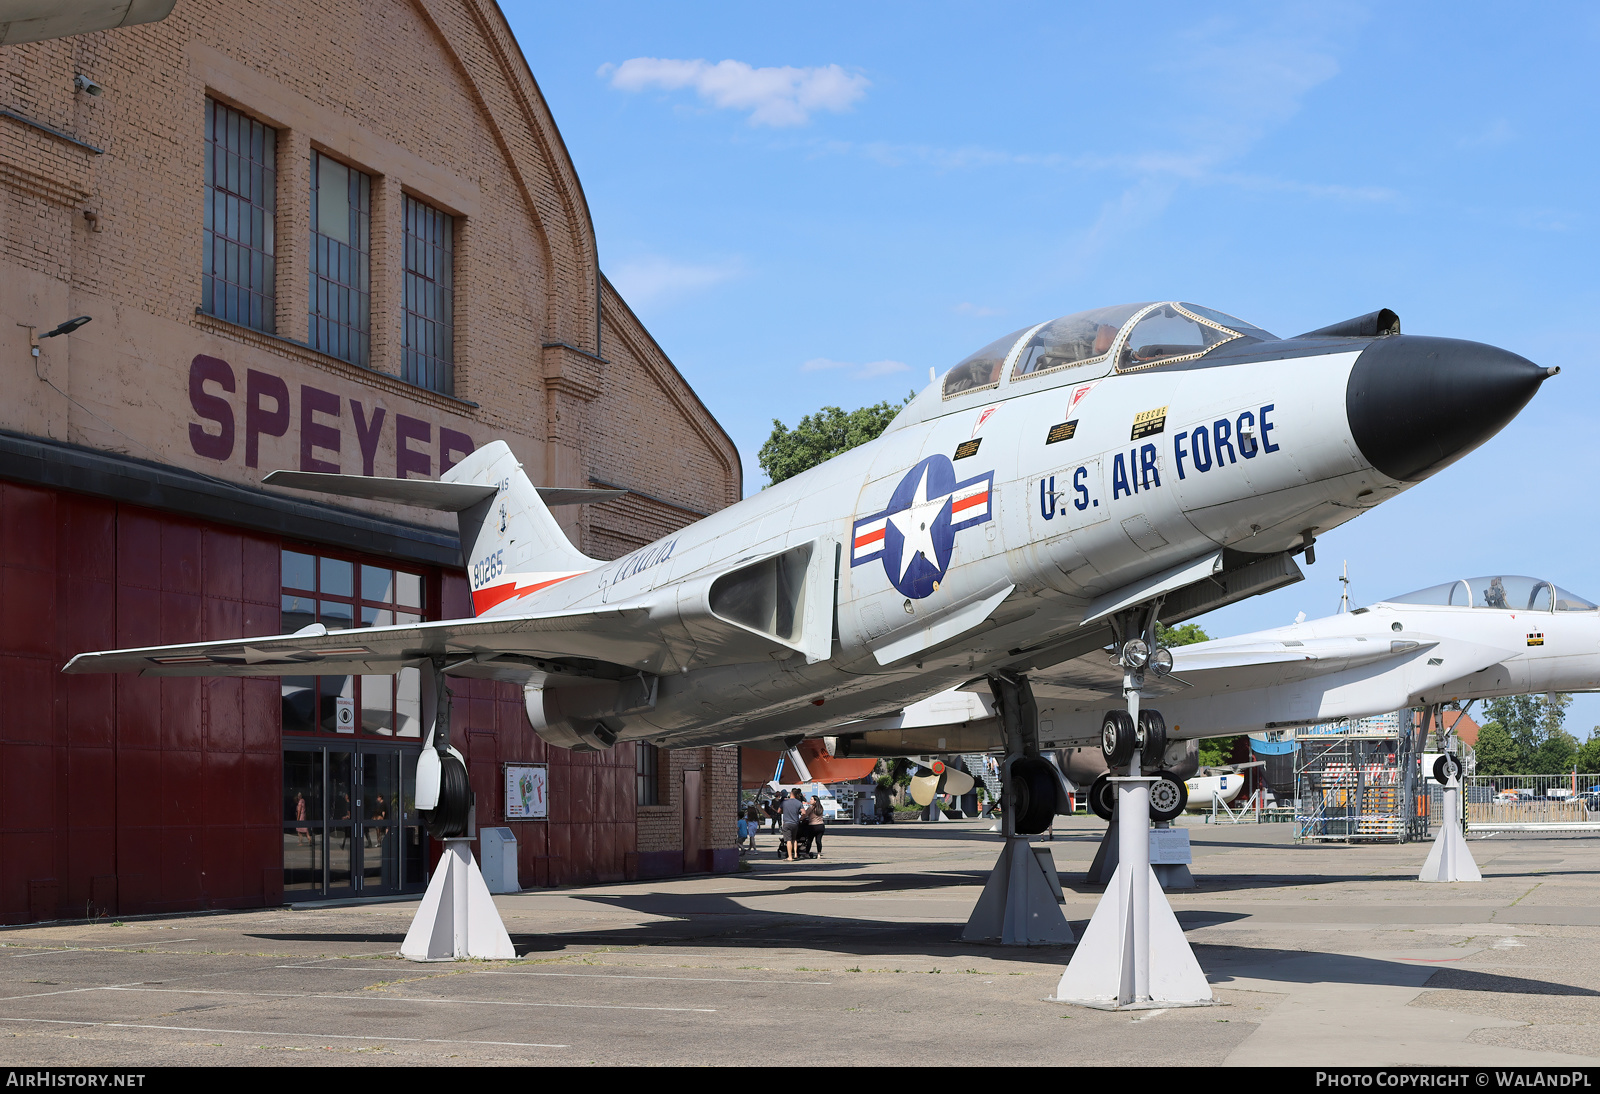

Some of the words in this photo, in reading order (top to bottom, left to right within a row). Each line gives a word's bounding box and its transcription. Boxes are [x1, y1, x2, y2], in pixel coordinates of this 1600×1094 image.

[1136, 406, 1166, 422] RESCUE
[1040, 466, 1099, 520] U.S.
[1113, 443, 1161, 500] AIR
[1174, 403, 1280, 480] FORCE
[473, 549, 503, 589] 80265
